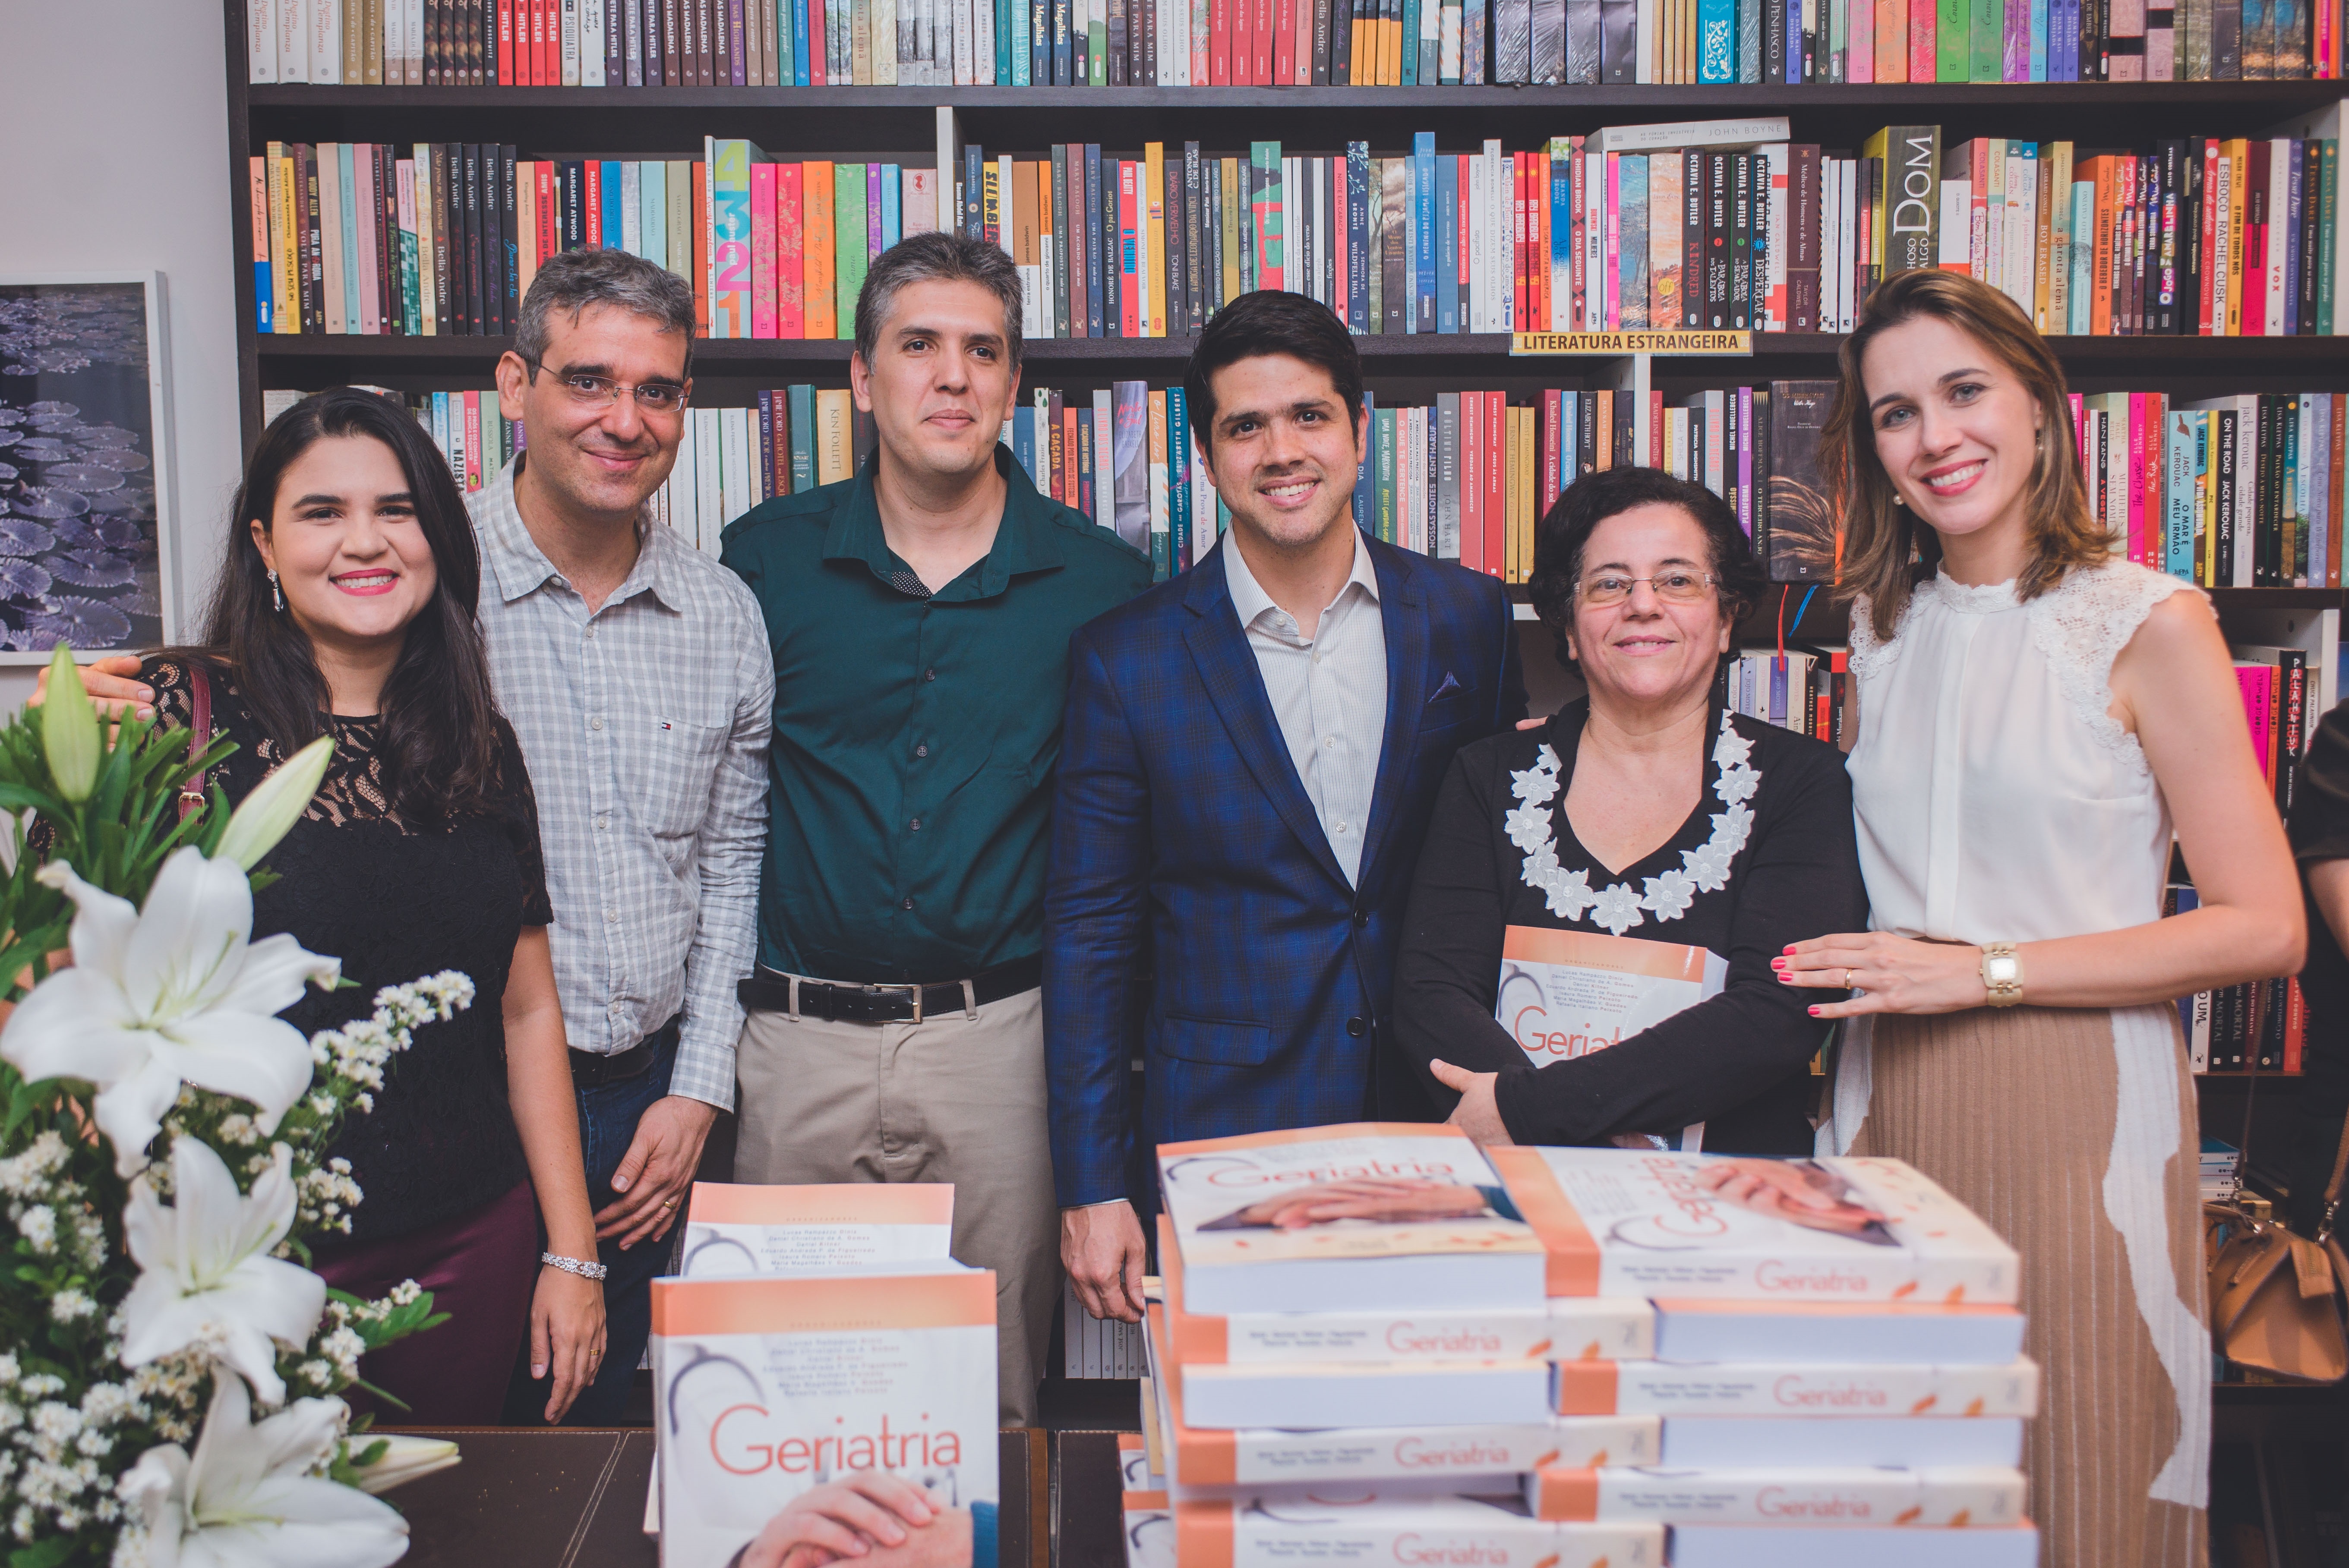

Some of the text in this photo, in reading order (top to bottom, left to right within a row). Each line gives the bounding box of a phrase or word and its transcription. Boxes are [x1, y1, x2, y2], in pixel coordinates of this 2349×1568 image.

[565, 16, 575, 60] PSIQUIATRA
[666, 14, 675, 55] MADALENAS
[684, 14, 692, 55] MADALENAS
[699, 13, 708, 54] MADALENAS
[717, 14, 726, 55] MADALENAS
[1770, 6, 1779, 59] PENHASCO
[1709, 125, 1781, 136] JOHN BOYNE
[1123, 167, 1133, 195] PAUL BEATTY
[1689, 155, 1698, 186] OCTAVIA
[1893, 134, 1933, 237] DOM
[308, 176, 320, 246] WOODY ALLEN PURA
[1170, 201, 1179, 245] VERMELHO
[1689, 198, 1698, 226] BUTLER
[727, 245, 738, 265] paul
[1124, 239, 1136, 273] VENDIDO
[2055, 237, 2064, 274] garota
[2216, 221, 2227, 268] RACHEL
[1109, 264, 1114, 272] DE
[1754, 259, 1764, 314] DESPERTAR
[2215, 271, 2226, 304] CUSK
[1525, 334, 1738, 349] LITERATURA ESTRANGEIRA
[830, 409, 841, 471] KEN FOLLETT
[2224, 419, 2232, 431] ON
[2239, 407, 2254, 470] jack kerouac
[1051, 434, 1061, 470] CAÇADA
[1400, 450, 1405, 459] TE
[2222, 481, 2230, 500] JACK
[2221, 502, 2229, 539] KEROUAC
[2172, 523, 2181, 555] IRMÃO
[1514, 1005, 1621, 1056] Geriat
[1208, 1157, 1455, 1187] Geriatria
[1753, 1258, 1868, 1293] Geriatria
[1384, 1319, 1502, 1354] Geriatria
[1772, 1374, 1888, 1408] Geriatria
[709, 1403, 961, 1475] Geriatria
[1394, 1438, 1512, 1468] Geriatria
[1754, 1486, 1872, 1519] Geriatria
[1392, 1531, 1511, 1566] Geriatria
